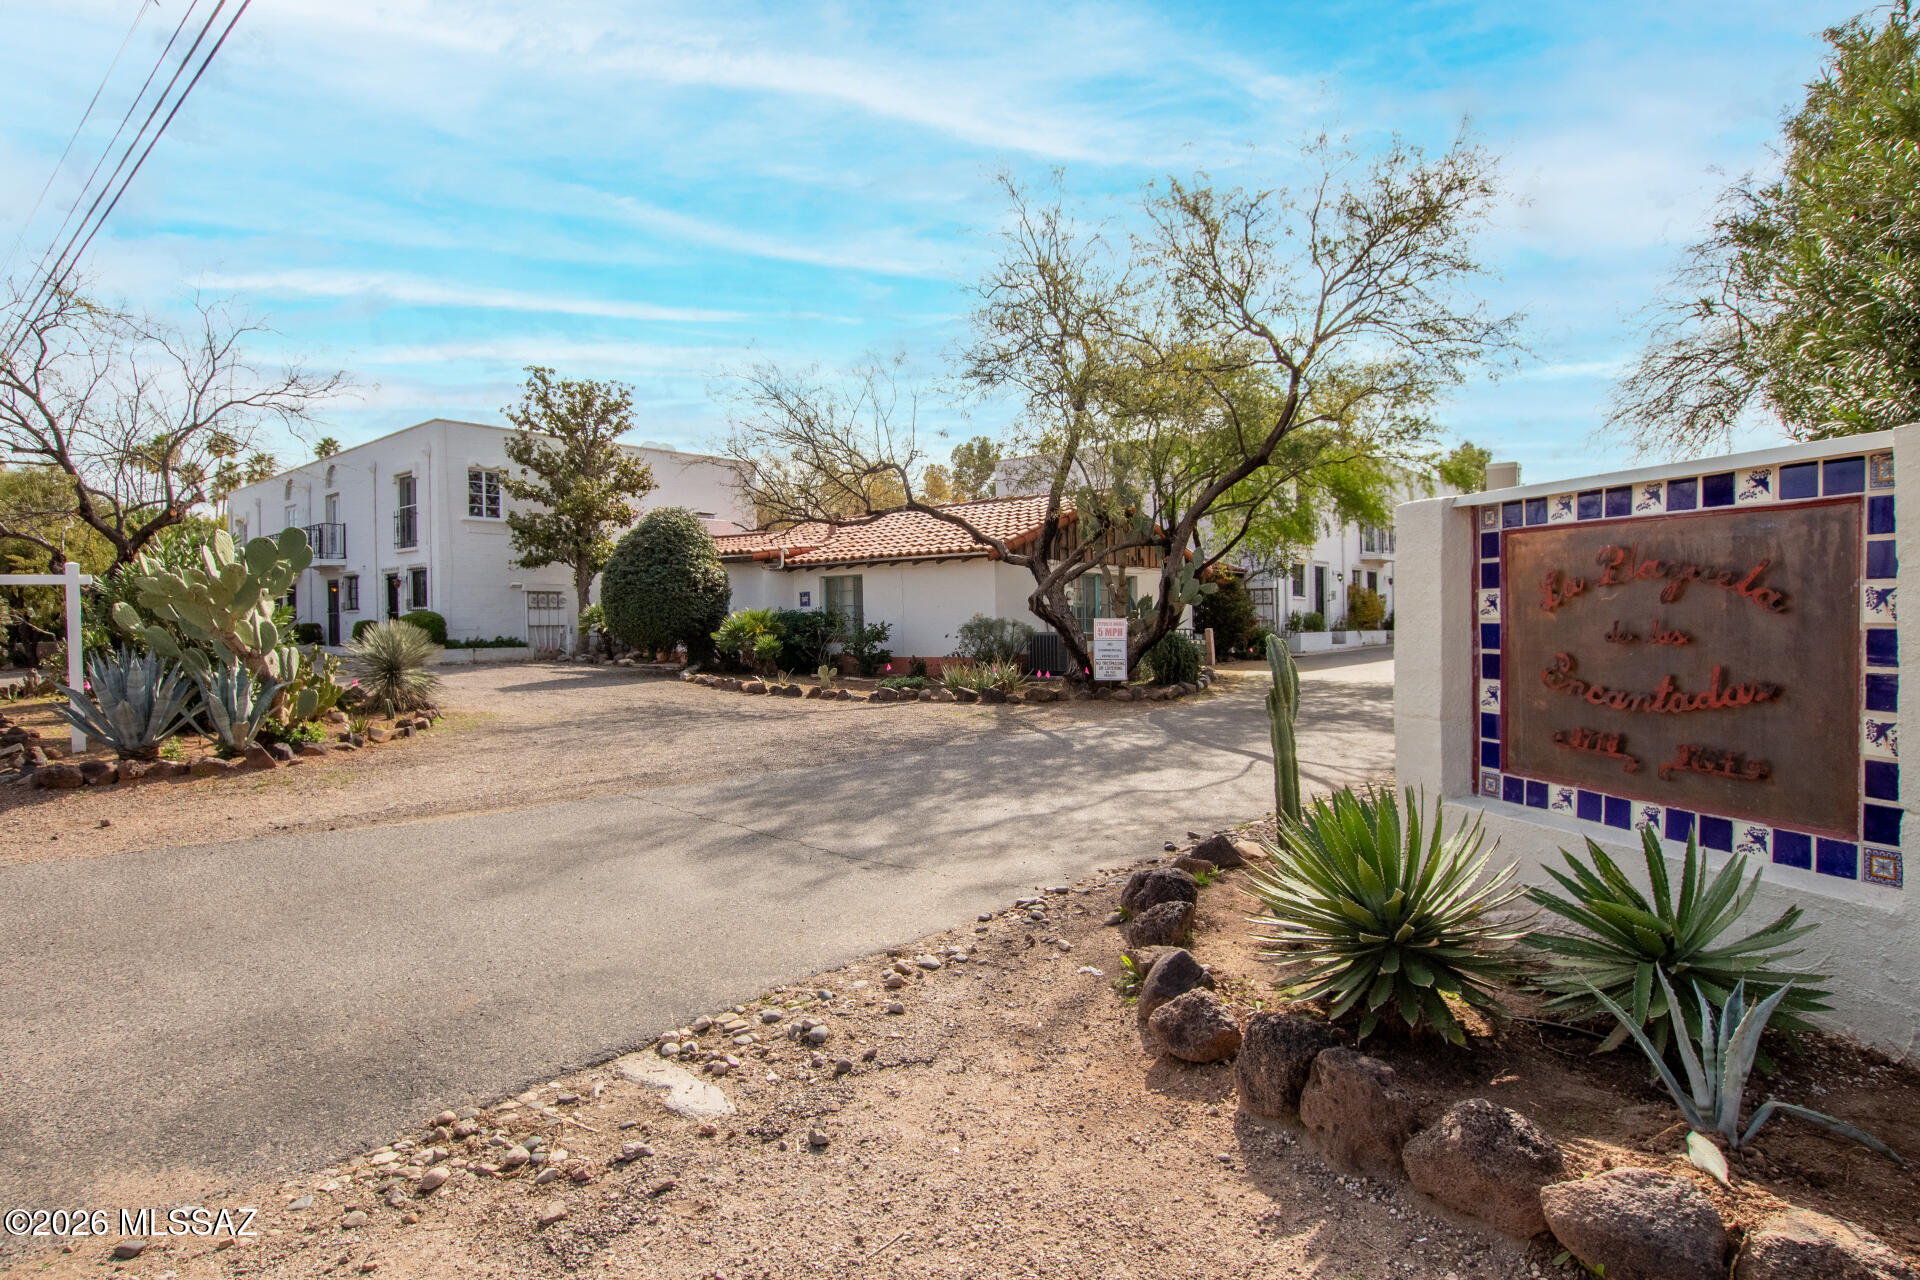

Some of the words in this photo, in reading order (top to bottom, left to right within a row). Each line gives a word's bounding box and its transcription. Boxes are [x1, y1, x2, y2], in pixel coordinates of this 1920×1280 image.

[1539, 568, 1585, 612] La
[1097, 628, 1103, 637] 5
[1104, 628, 1123, 637] MPH
[1604, 620, 1638, 644] de
